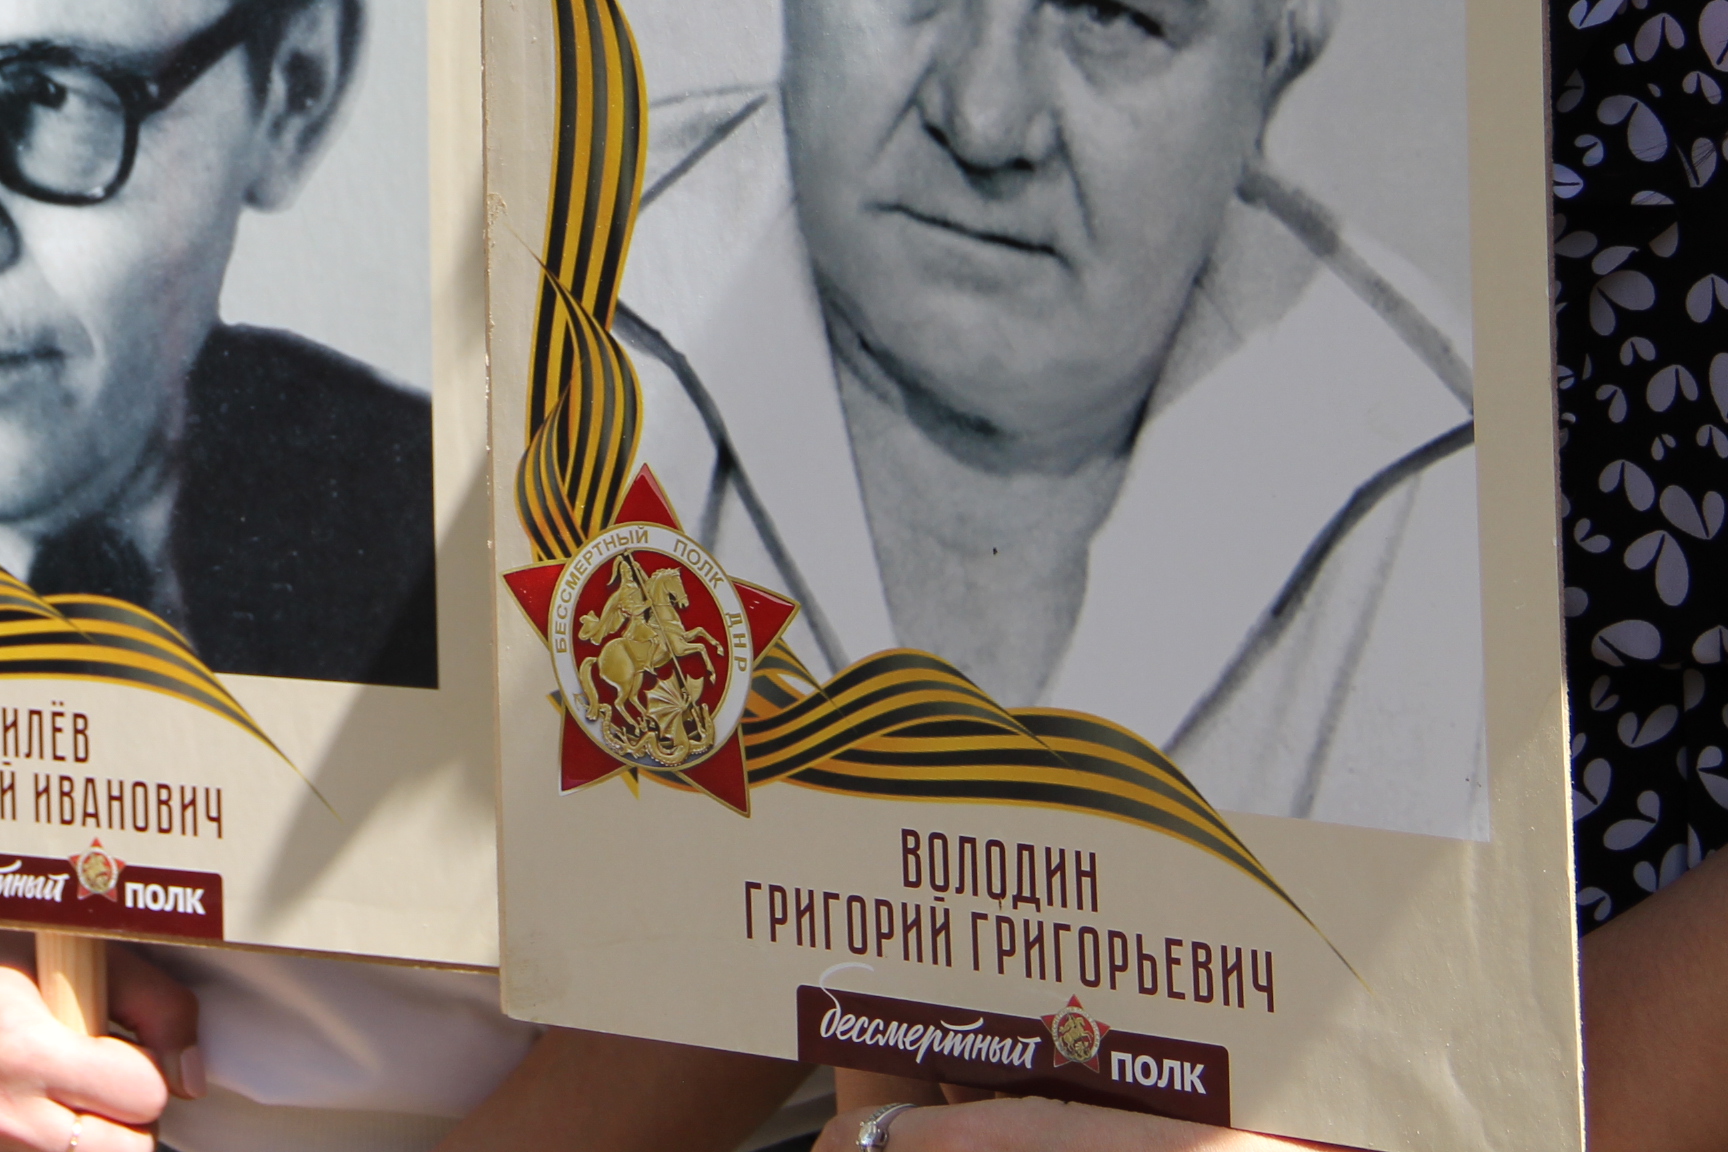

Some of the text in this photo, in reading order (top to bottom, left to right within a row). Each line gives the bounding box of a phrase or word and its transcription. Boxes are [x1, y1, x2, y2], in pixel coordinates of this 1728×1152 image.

[555, 525, 747, 673] БЕССМЕРТНЫЙ ПОЛК ДНР
[33, 772, 224, 840] ИВАНОВИЧ
[901, 827, 1098, 913] ВОЛОДИН
[744, 880, 1275, 1013] ГРИГОРИЙ ГРИГОРЬЕВИЧ
[819, 961, 1041, 1069] бессмертный
